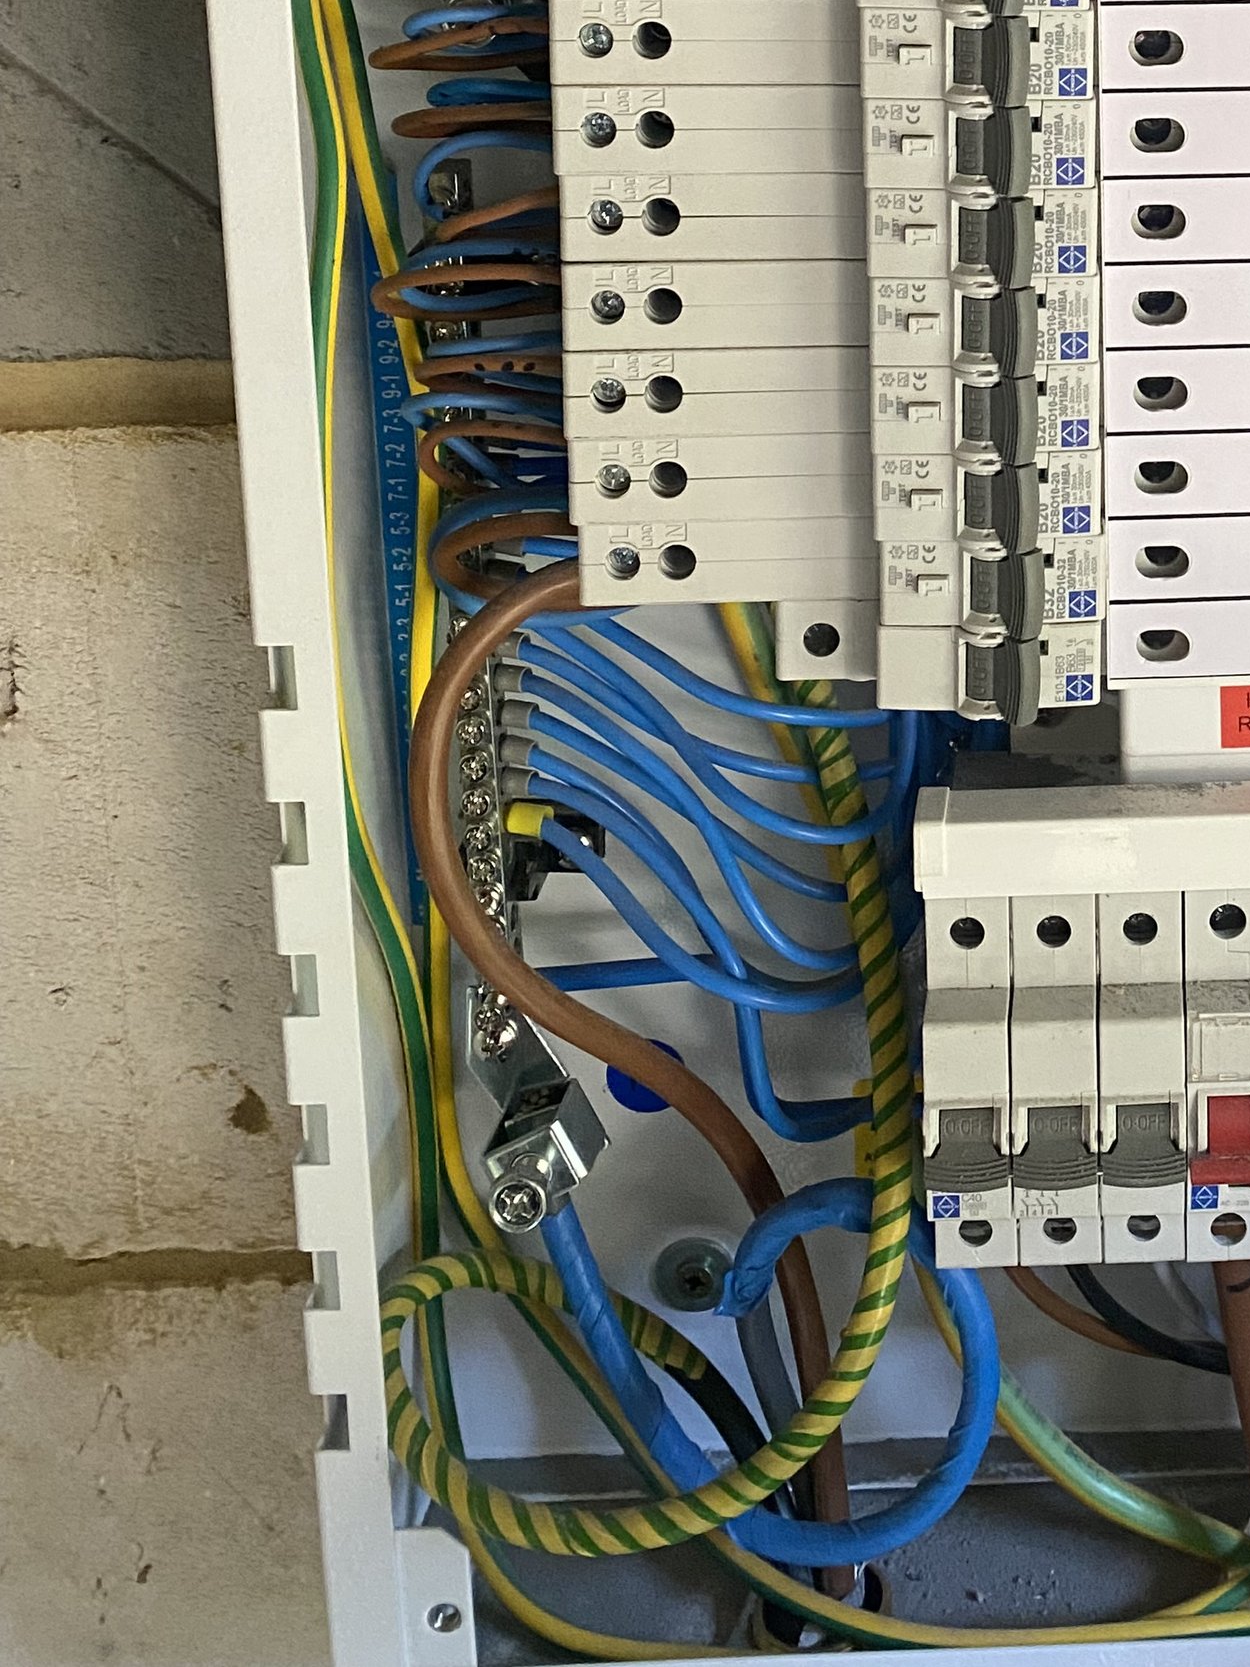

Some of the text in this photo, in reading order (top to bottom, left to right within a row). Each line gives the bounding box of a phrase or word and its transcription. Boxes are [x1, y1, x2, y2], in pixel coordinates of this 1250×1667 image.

[378, 339, 399, 365] 9-2
[379, 374, 402, 399] 9-1
[383, 444, 405, 468] 7-2
[385, 478, 408, 501] 7-1
[391, 547, 412, 572] 5-2
